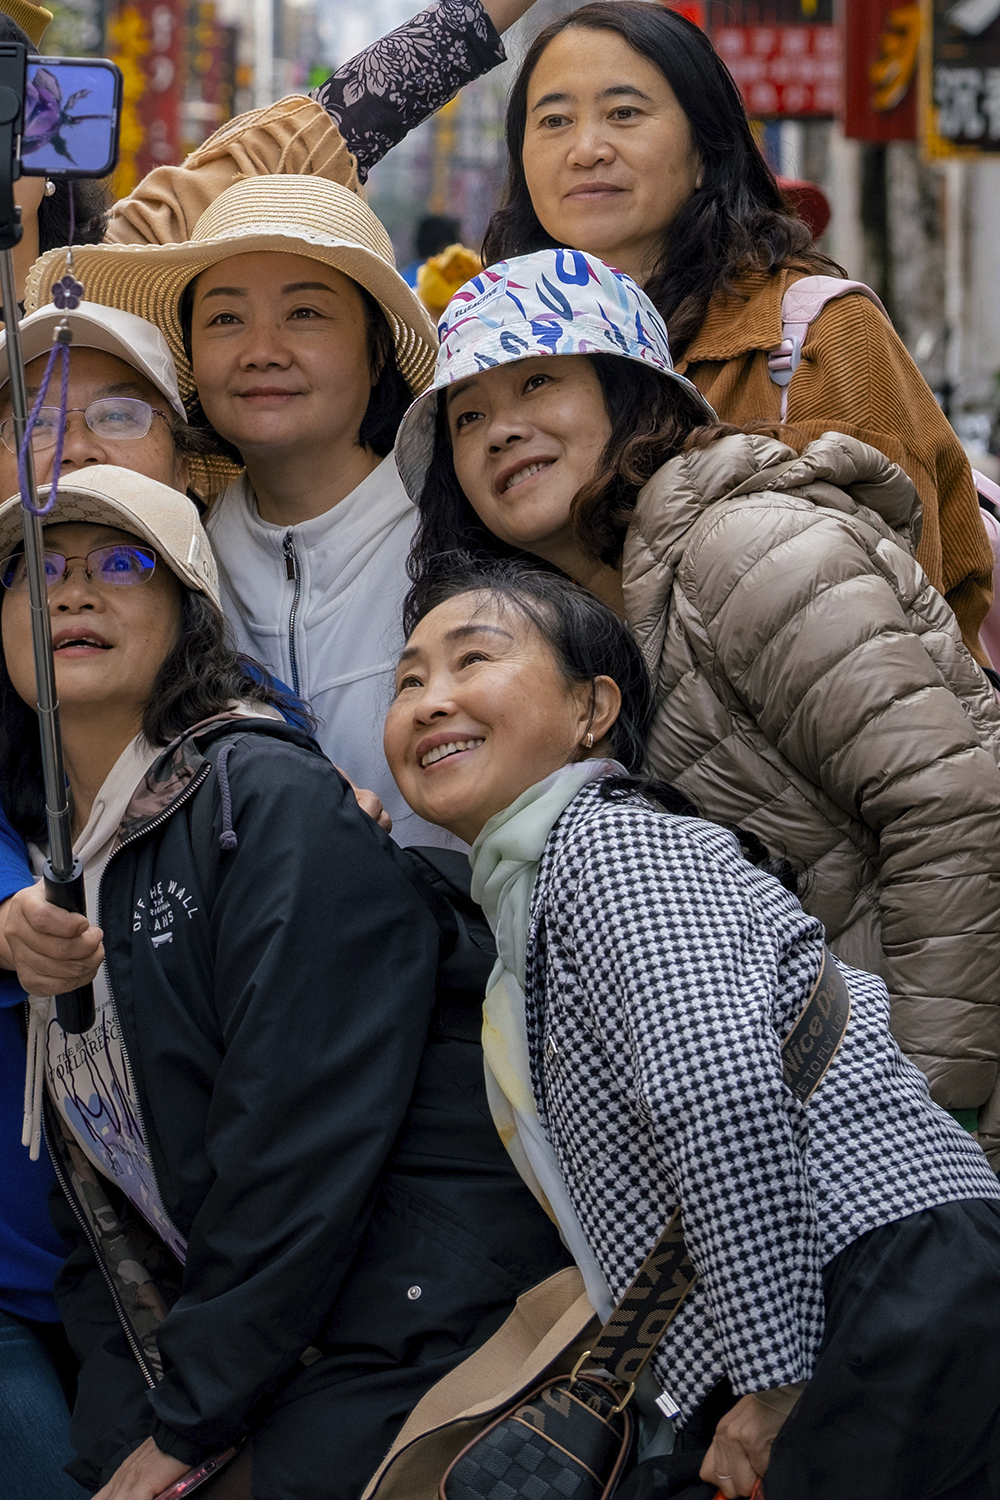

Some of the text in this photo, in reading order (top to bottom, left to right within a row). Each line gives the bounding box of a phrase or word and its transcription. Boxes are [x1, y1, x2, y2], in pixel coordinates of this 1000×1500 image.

[132, 879, 199, 932] OFF HE WALL
[149, 910, 174, 931] ANS
[804, 1060, 822, 1080] TO
[817, 1033, 835, 1062] FLY
